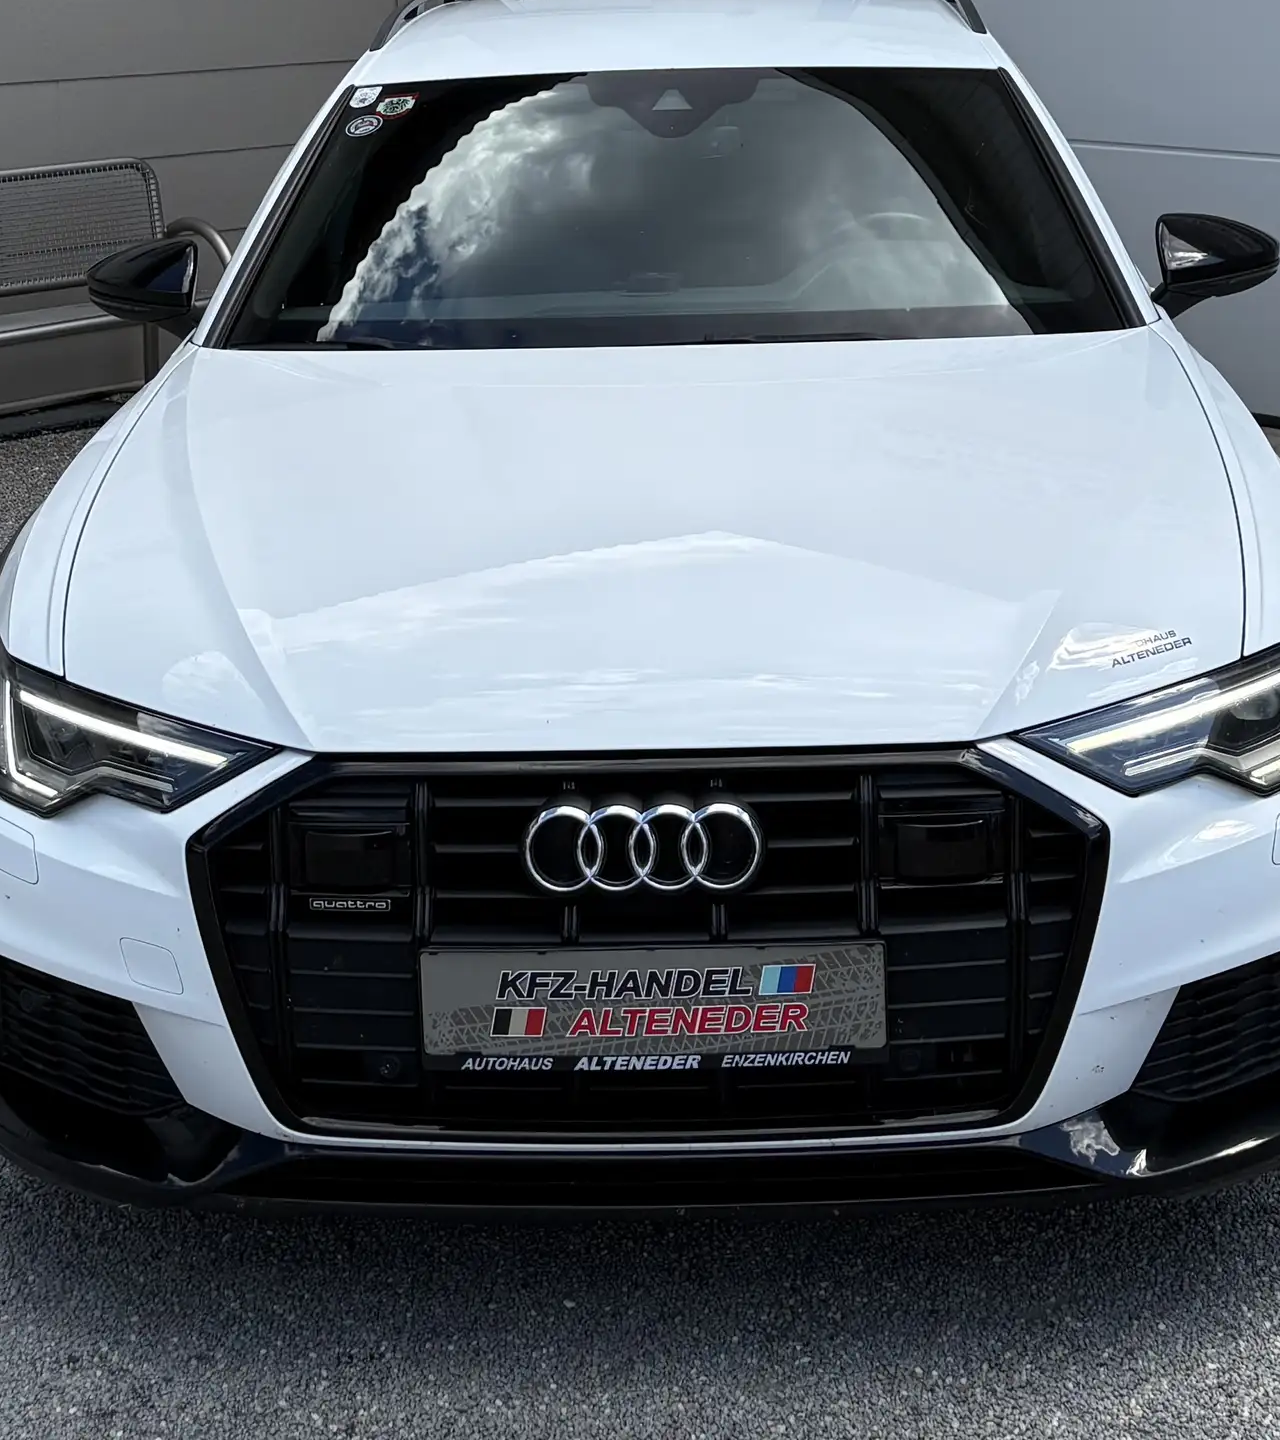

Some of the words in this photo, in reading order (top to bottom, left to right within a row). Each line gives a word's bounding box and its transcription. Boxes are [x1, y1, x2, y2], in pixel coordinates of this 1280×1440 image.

[1112, 637, 1193, 669] ALTENEDER
[313, 900, 387, 910] quattro
[495, 966, 753, 1001] KFZ-HANDEL
[566, 1003, 810, 1038] ALTENEDER
[461, 1057, 554, 1071] AUTOHAUS
[574, 1054, 702, 1071] ALTENEDER
[721, 1051, 851, 1068] ENZENKIRCHEN
